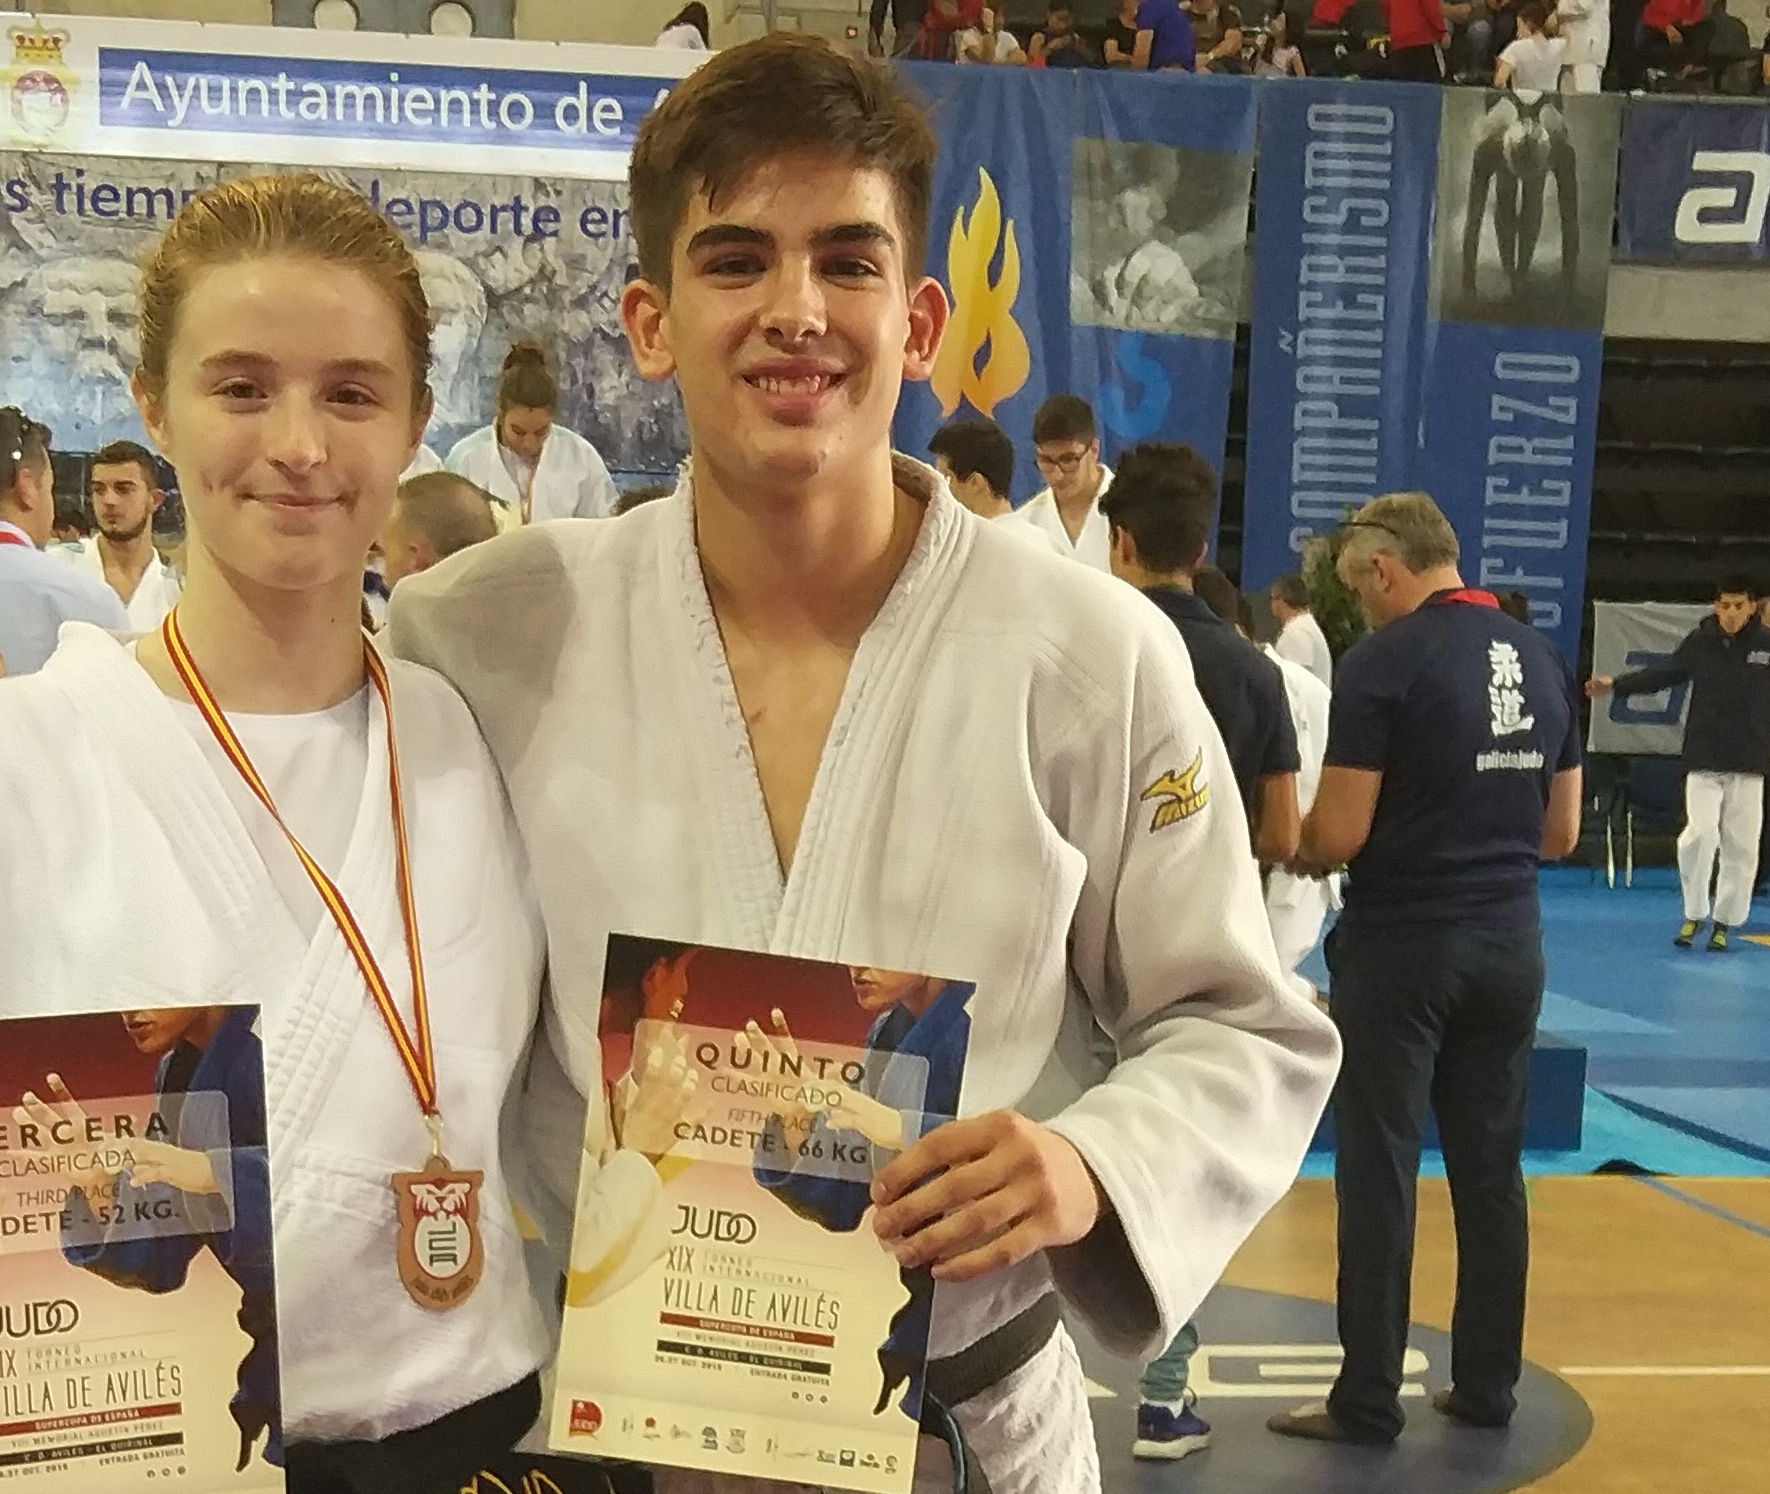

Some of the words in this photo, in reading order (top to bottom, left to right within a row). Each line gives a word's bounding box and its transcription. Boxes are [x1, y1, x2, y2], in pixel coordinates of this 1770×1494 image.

[120, 61, 535, 132] Ayuntamiento
[554, 80, 624, 136] de
[51, 168, 199, 221] tiem
[695, 1041, 866, 1084] QUINTO
[711, 1075, 843, 1108] CLASIFICADO
[673, 1122, 776, 1152] CADETE
[798, 1138, 824, 1158] 66
[16, 1187, 68, 1208] THIRD
[98, 1204, 127, 1226] 52
[670, 1204, 758, 1245] JUDO
[665, 1244, 695, 1275] XIX
[663, 1276, 719, 1314] VILLA
[731, 1286, 758, 1319] DE
[766, 1291, 841, 1331] AVILÉS
[65, 1375, 93, 1410] DE
[105, 1360, 183, 1406] AVILÉS
